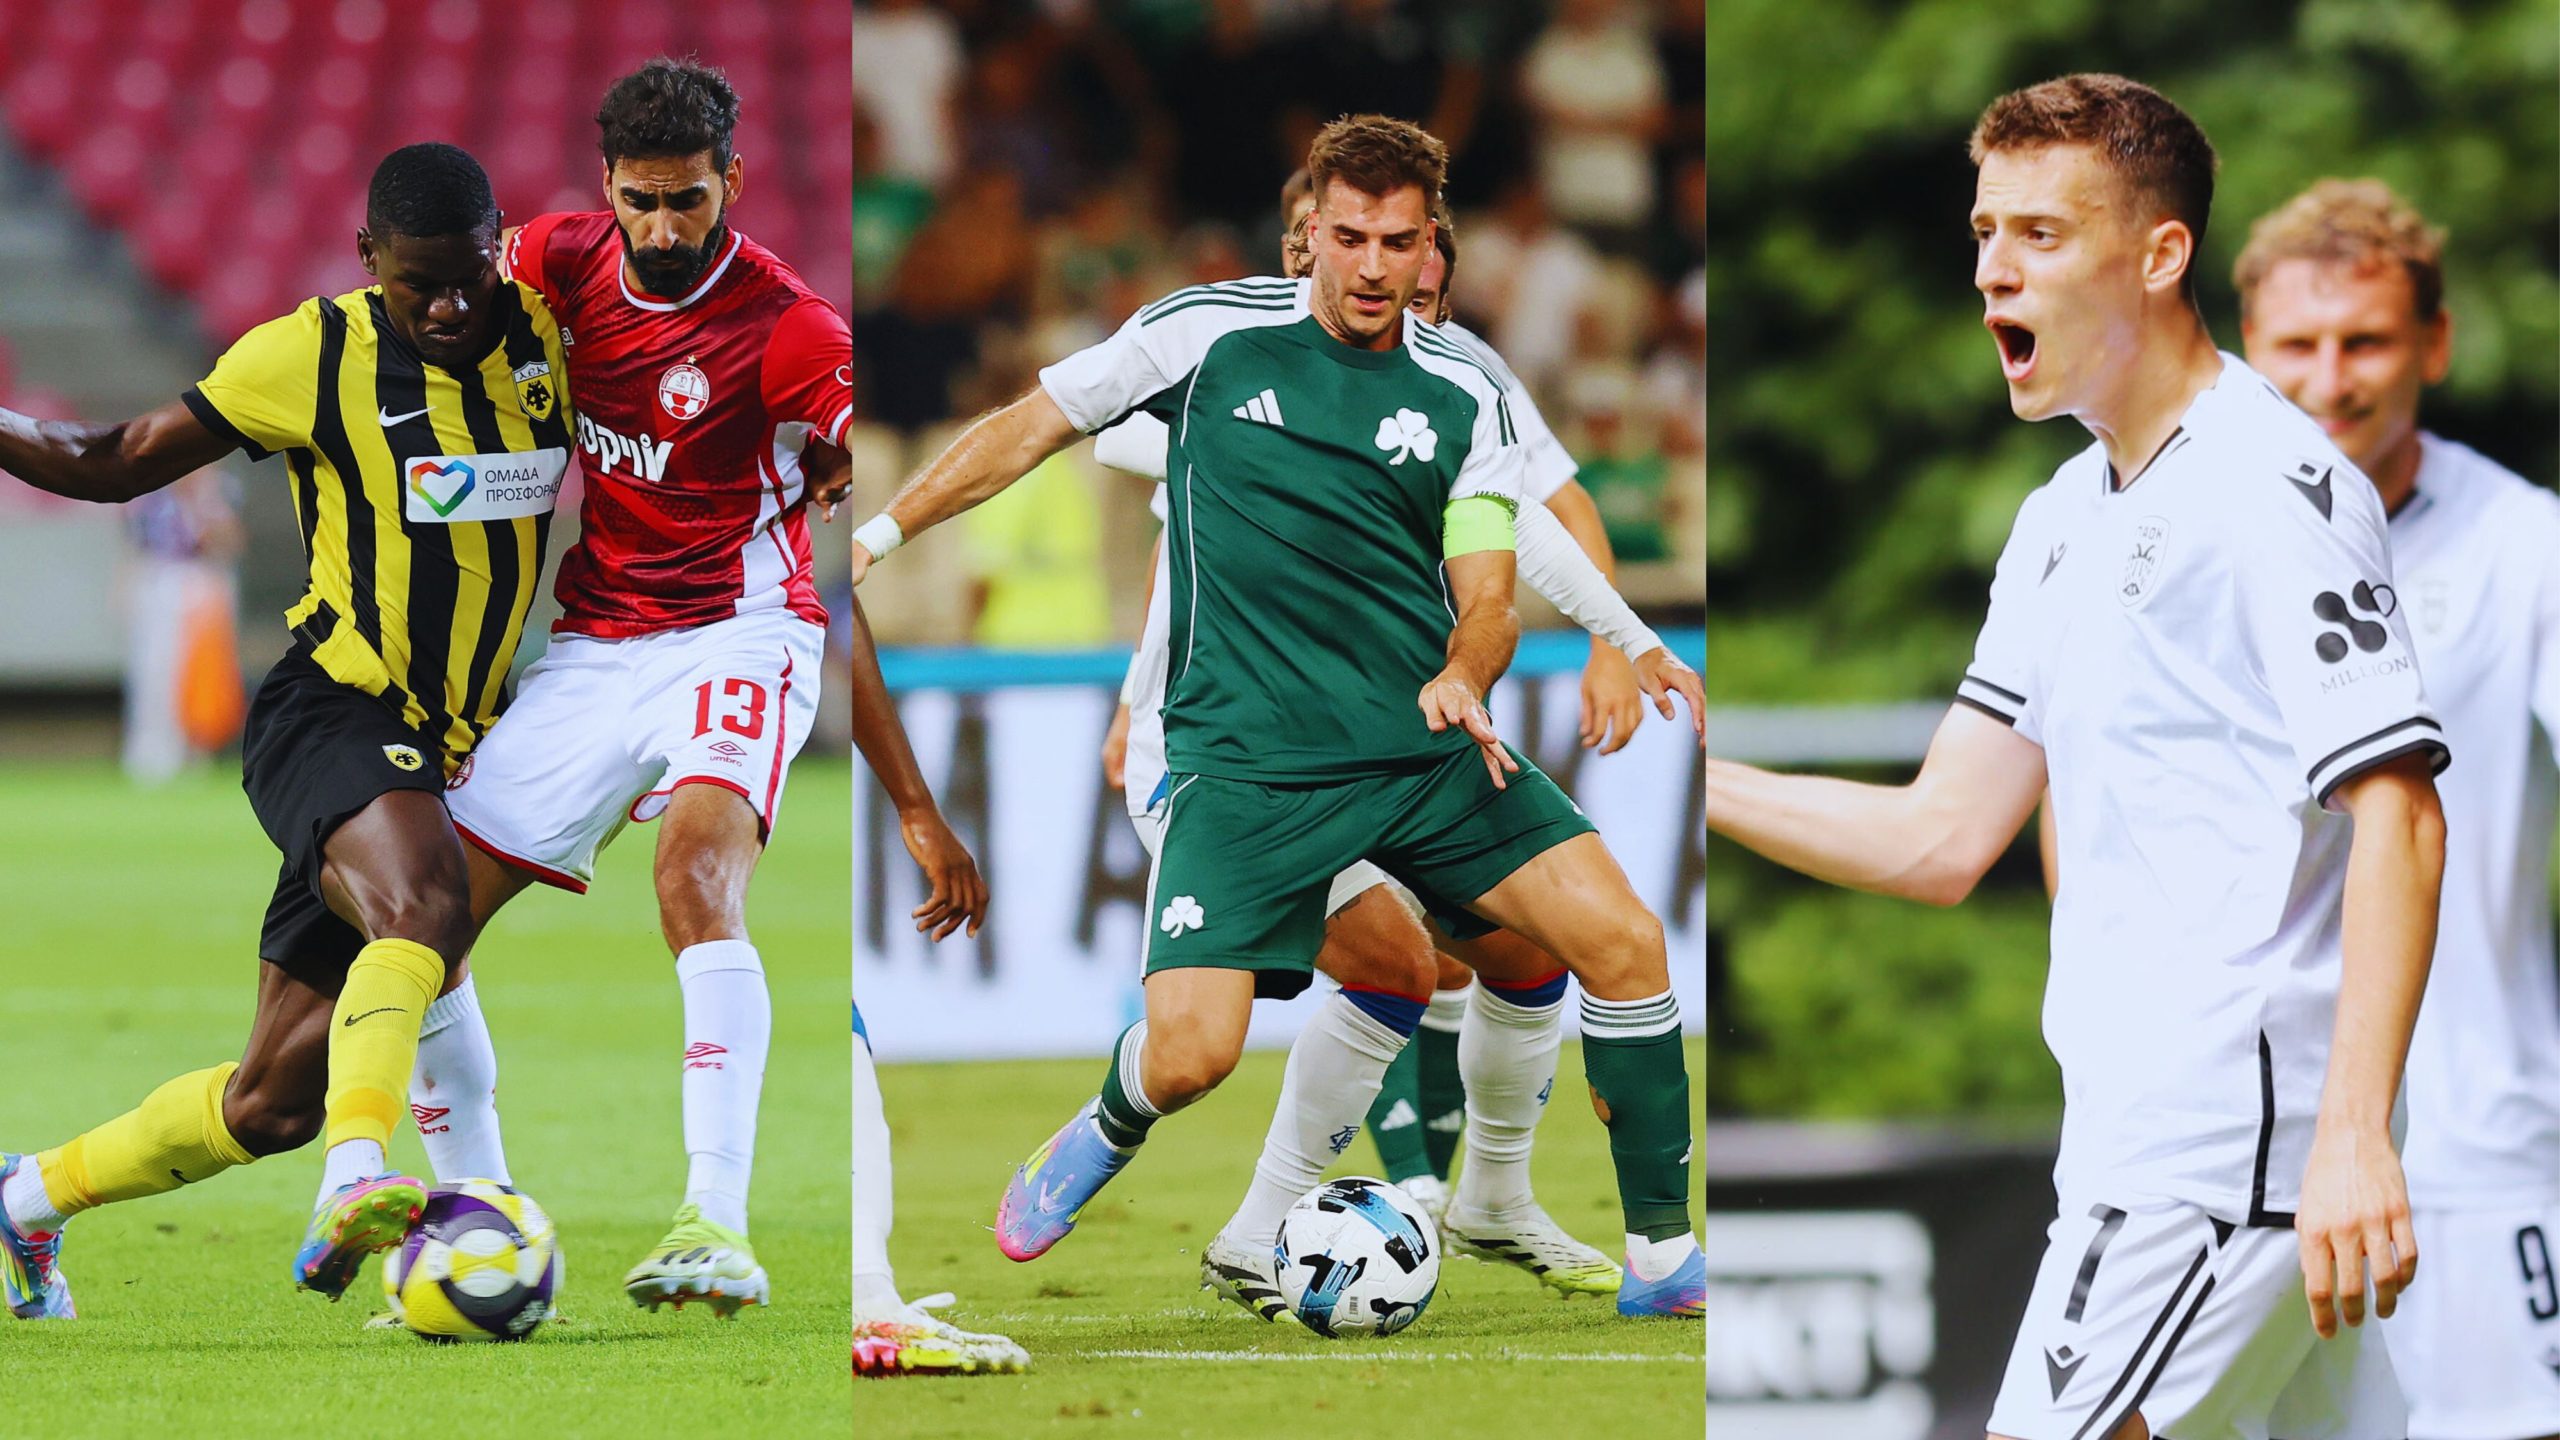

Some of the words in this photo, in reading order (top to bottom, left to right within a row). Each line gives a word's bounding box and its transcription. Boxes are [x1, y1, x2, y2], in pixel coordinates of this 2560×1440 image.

[485, 467, 539, 483] ΟΜΑΔΑ
[2319, 656, 2409, 695] MILLION
[691, 678, 767, 740] 13
[709, 755, 742, 767] umbro
[2064, 1203, 2128, 1325] 7
[2517, 1225, 2559, 1322] 9
